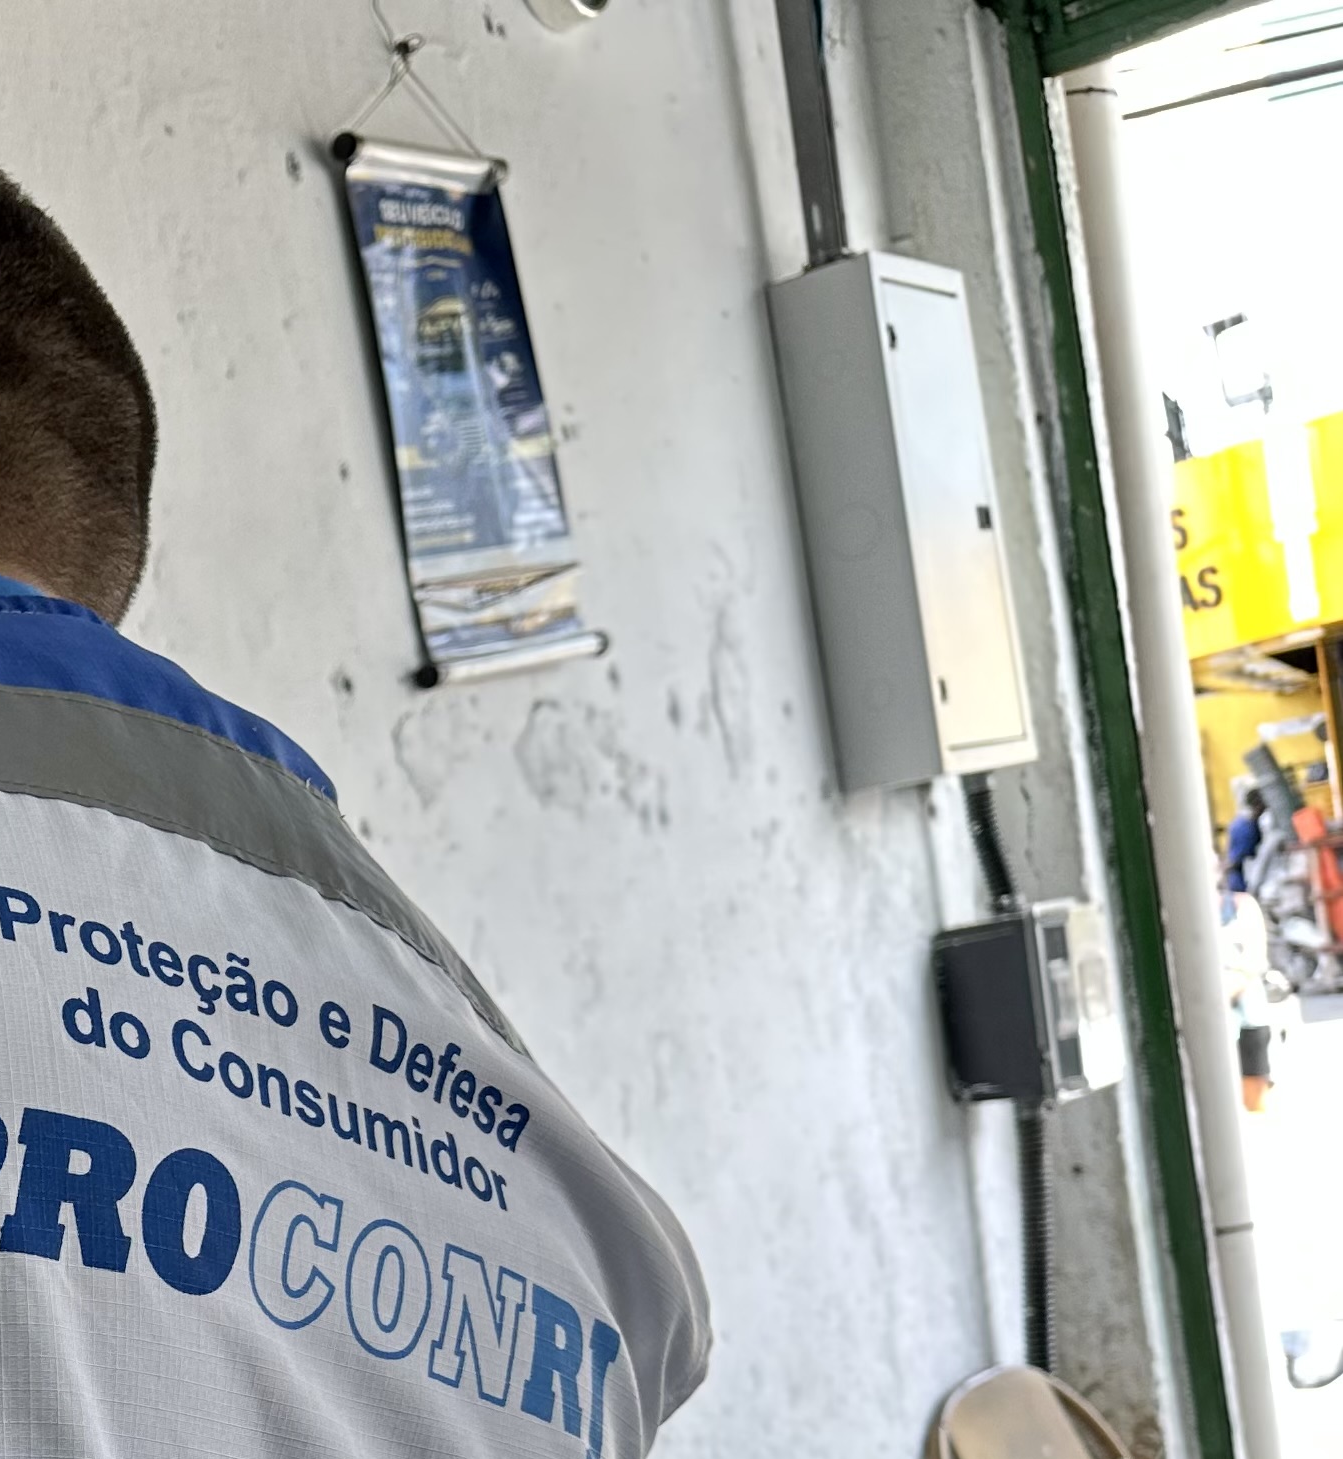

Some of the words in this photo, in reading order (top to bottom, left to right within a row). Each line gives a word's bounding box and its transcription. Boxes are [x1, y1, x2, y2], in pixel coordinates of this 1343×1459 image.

[62, 988, 151, 1060] do
[172, 1019, 508, 1211] Consumidor
[319, 1001, 351, 1049] e
[369, 1003, 530, 1153] Defesa
